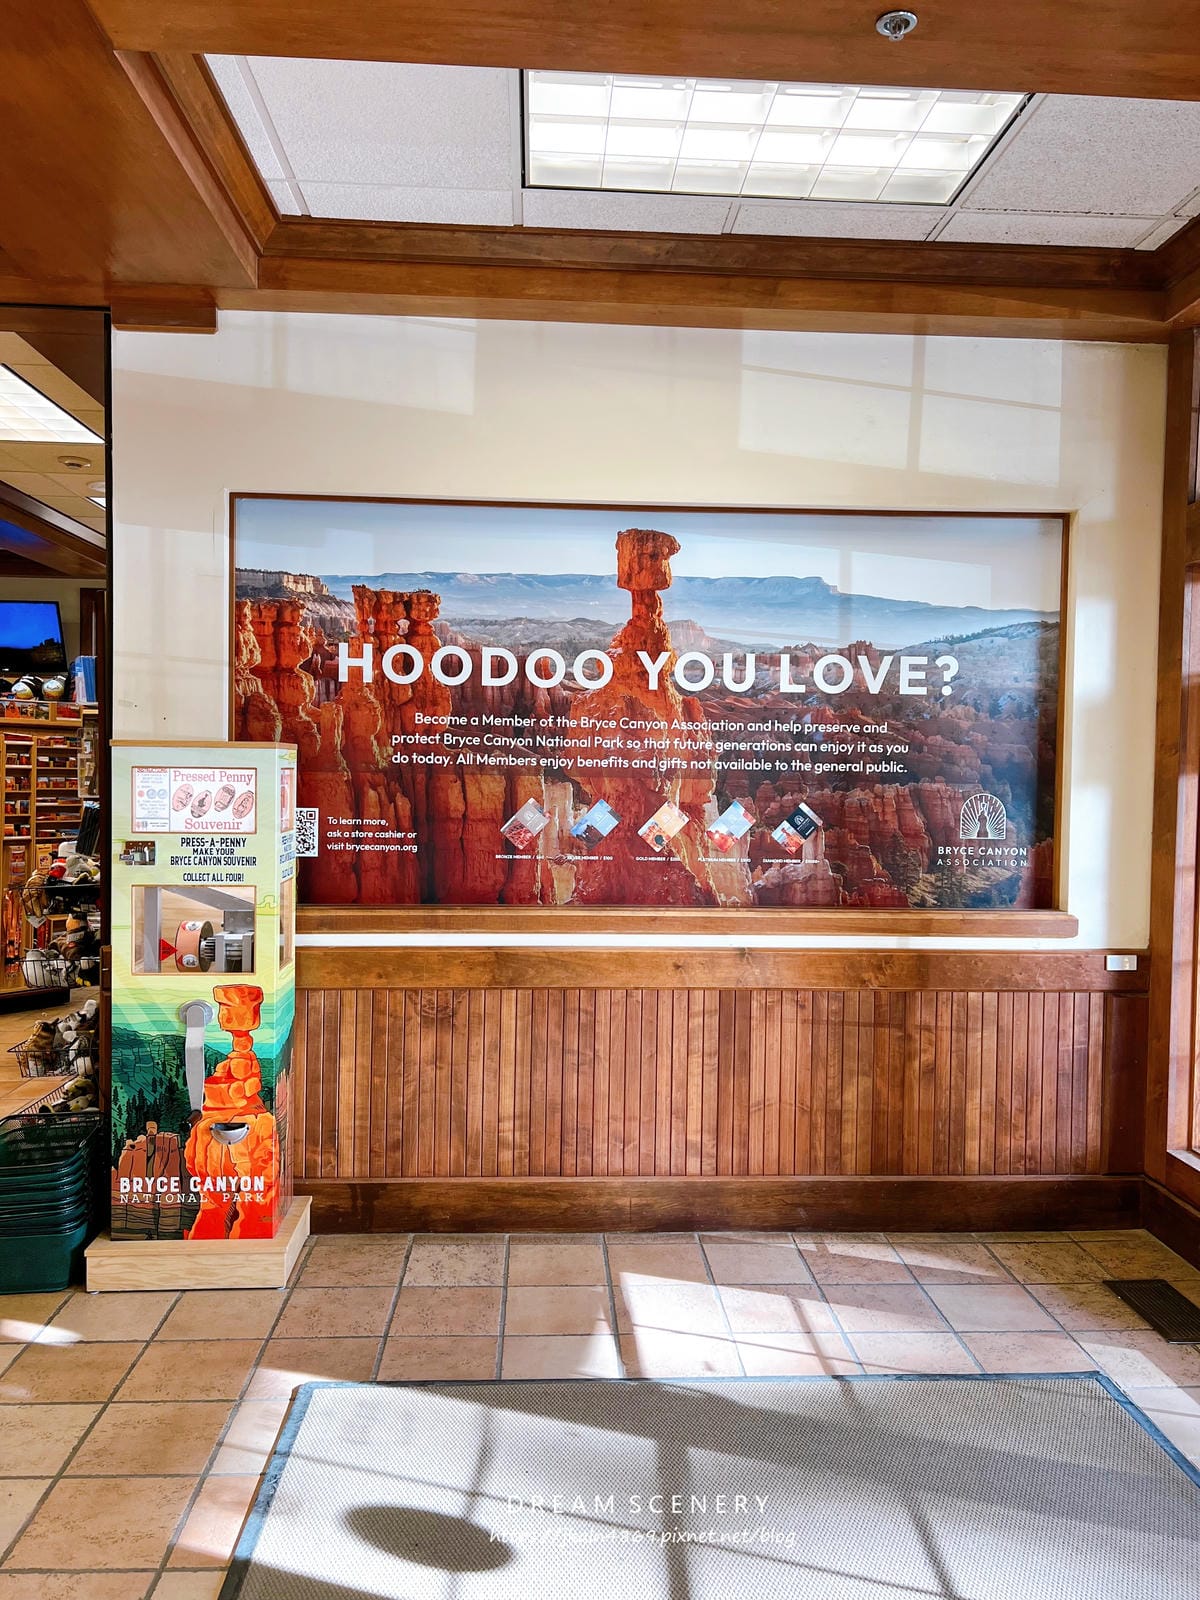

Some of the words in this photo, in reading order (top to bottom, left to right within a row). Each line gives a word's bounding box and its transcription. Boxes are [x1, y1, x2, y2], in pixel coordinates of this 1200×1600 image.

[338, 642, 614, 690] HOODOO
[636, 650, 756, 693] YOU
[780, 654, 960, 696] LOVE?
[414, 712, 468, 725] Become
[470, 716, 479, 726] a
[482, 714, 536, 726] Member
[539, 715, 554, 728] of
[557, 716, 578, 728] the
[580, 716, 616, 731] Bryce
[620, 717, 668, 732] Canyon
[671, 718, 744, 731] Association
[747, 720, 772, 732] and
[774, 720, 802, 734] help
[804, 724, 860, 734] preserve
[863, 722, 888, 734] and
[392, 732, 440, 746] protect
[444, 733, 480, 748] Bryce
[484, 734, 533, 748] Canyon
[536, 734, 590, 748] National
[594, 736, 623, 748] Park
[626, 740, 640, 749] so
[644, 738, 670, 750] that
[674, 738, 712, 750] future
[716, 740, 792, 752] generations
[794, 743, 818, 752] can
[820, 742, 855, 756] enjoy
[857, 742, 866, 753] it
[868, 744, 883, 753] as
[886, 744, 908, 756] you
[392, 752, 408, 764] do
[412, 752, 453, 767] today.
[456, 753, 473, 765] All
[476, 754, 537, 767] Members
[540, 756, 574, 770] enjoy
[578, 756, 629, 768] benefits
[632, 756, 656, 769] and
[659, 757, 688, 771] gifts
[690, 759, 712, 770] not
[714, 759, 772, 771] available
[775, 760, 788, 771] to
[791, 759, 812, 772] the
[814, 760, 863, 774] general
[866, 761, 908, 775] public.
[173, 770, 216, 782] Pressed
[220, 771, 253, 785] Penny
[184, 818, 242, 830] Souvenir
[327, 817, 338, 825] To
[340, 817, 362, 825] learn
[327, 829, 342, 838] ask
[374, 830, 406, 838] cashier
[181, 837, 247, 847] PRESS-A-PENNY
[327, 842, 344, 850] visit
[346, 843, 418, 853] brycecanyon.org
[938, 846, 975, 855] BRYCE
[979, 847, 1027, 856] CANYON
[170, 856, 192, 866] BRYCE
[194, 856, 222, 866] CANYON
[224, 856, 256, 866] SOUVENIR
[183, 873, 210, 882] COLLECT
[212, 873, 224, 882] ALL
[226, 873, 244, 882] FOUR!
[120, 1176, 180, 1193] BRYCE
[189, 1176, 264, 1192] CANYON
[120, 1194, 208, 1203] NATIONAL
[223, 1193, 264, 1202] PARK
